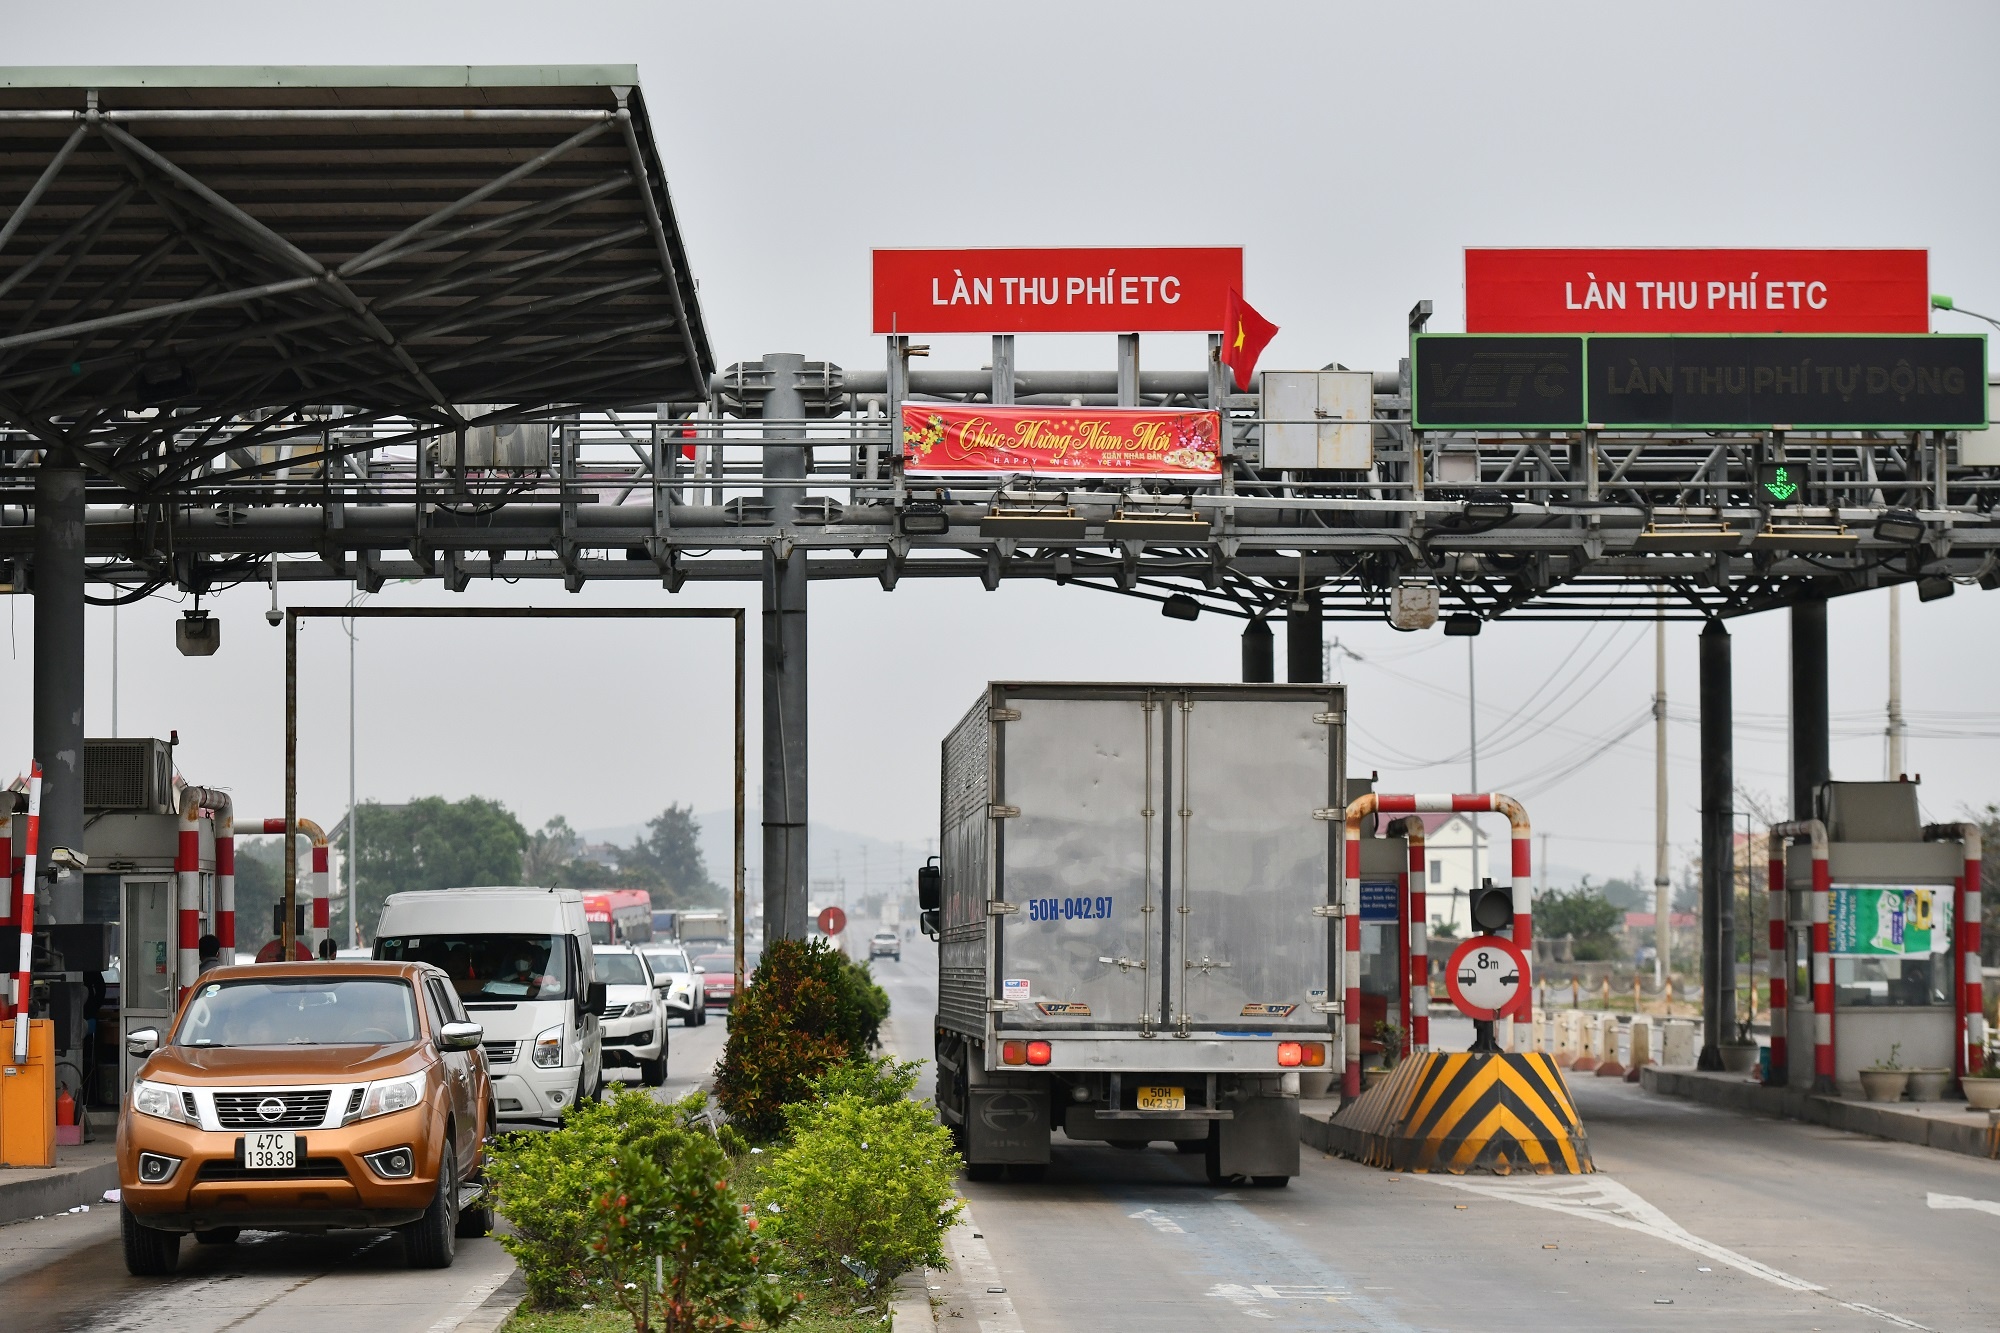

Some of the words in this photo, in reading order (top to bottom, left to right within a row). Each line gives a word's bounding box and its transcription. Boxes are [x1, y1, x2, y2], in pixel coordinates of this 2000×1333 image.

[932, 269, 993, 305] LÀN
[999, 277, 1059, 305] THU
[1066, 268, 1116, 305] PHÍ
[1120, 276, 1181, 305] ETC
[1565, 271, 1626, 310] LÀN
[1635, 281, 1698, 310] THU
[1707, 271, 1759, 310] PHÍ
[1765, 280, 1828, 310] ETC
[1607, 358, 1673, 394] LÀN
[1680, 366, 1746, 394] THU
[1754, 358, 1812, 394] PHÍ
[1815, 364, 1862, 402] TỰ
[1865, 359, 1966, 402] ĐỘNG
[954, 416, 1006, 453] Chúc
[1006, 419, 1073, 459] Mừng
[1072, 420, 1122, 450] Năm
[1124, 421, 1172, 451] Mới
[993, 457, 1038, 465] HAPPY
[1053, 458, 1082, 466] NEW
[1097, 459, 1132, 467] YEAR
[1029, 896, 1113, 922] 50H-042.97
[1142, 1098, 1180, 1108] 042.97
[1150, 1088, 1171, 1098] 50H
[257, 1134, 284, 1150] 47C
[247, 1151, 294, 1167] 138.38
